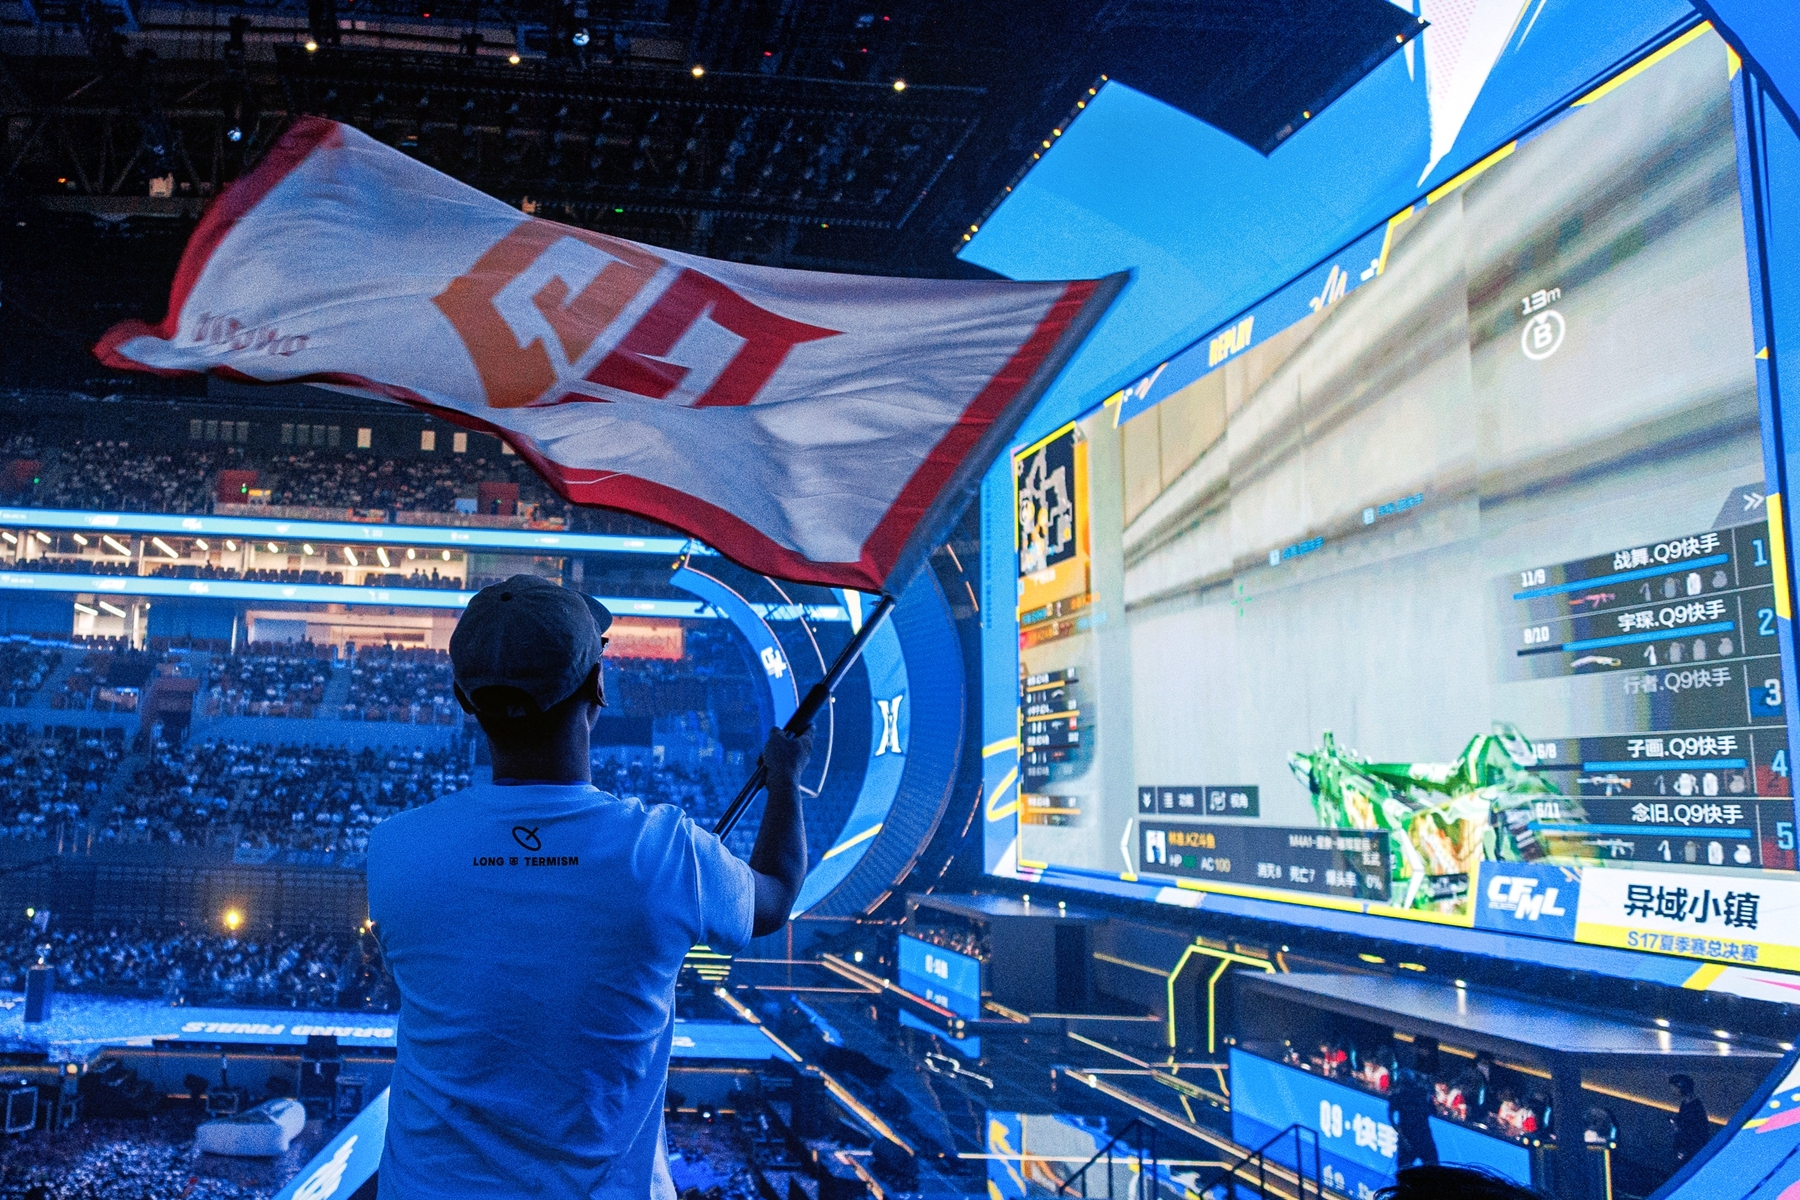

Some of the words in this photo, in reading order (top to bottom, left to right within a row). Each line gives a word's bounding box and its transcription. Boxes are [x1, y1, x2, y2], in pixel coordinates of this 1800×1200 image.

[1521, 287, 1561, 316] 13m
[1533, 323, 1553, 349] B
[1752, 539, 1768, 567] 1
[1758, 608, 1776, 636] 2
[1764, 678, 1782, 706] 3
[1771, 749, 1789, 778] 4
[1776, 821, 1795, 850] 5
[473, 856, 504, 867] LONG
[524, 856, 579, 867] TERMISM
[1623, 884, 1760, 930] 异域小镇
